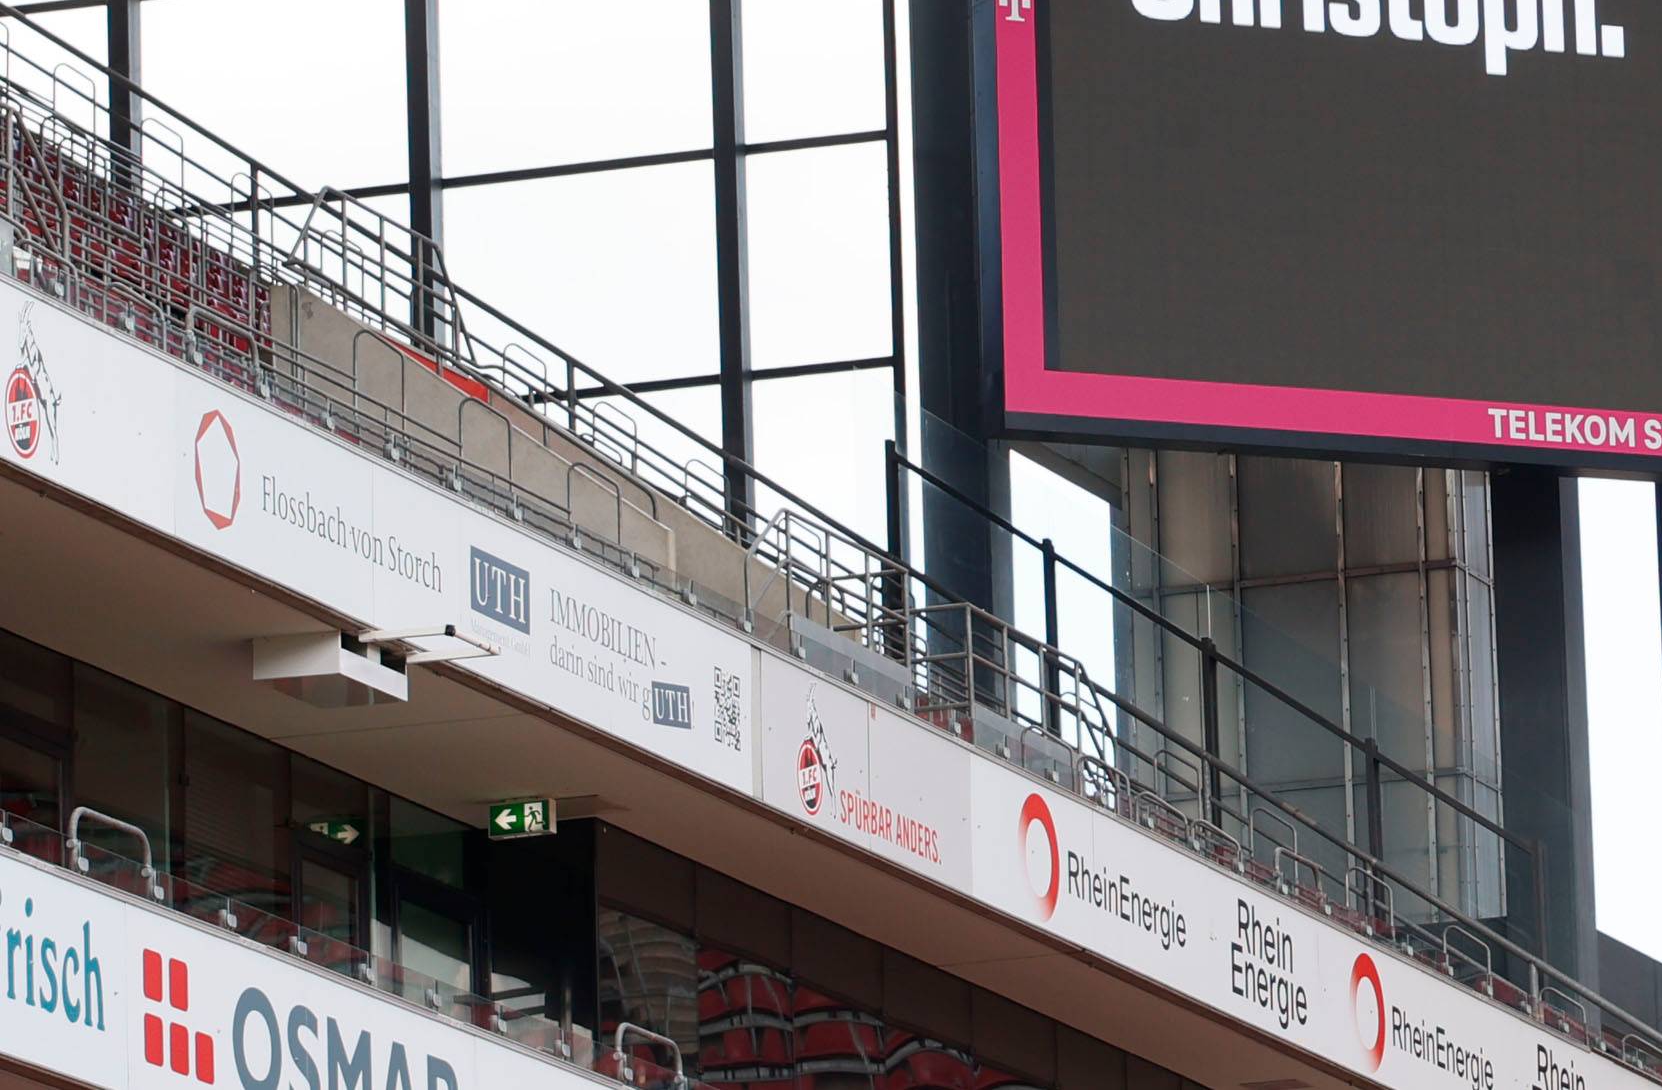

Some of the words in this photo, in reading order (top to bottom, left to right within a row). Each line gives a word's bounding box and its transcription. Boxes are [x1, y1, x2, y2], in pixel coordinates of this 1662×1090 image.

[1487, 407, 1637, 448] TELEKOM
[262, 474, 348, 549] Flossbach
[350, 525, 384, 566] von
[388, 535, 443, 594] Storch
[473, 556, 527, 624] UTH
[549, 587, 657, 671] IMMOBILIEN
[550, 635, 585, 679] darin
[587, 654, 615, 693] sind
[617, 667, 641, 703] wir
[839, 789, 893, 843] SPÜRBAR
[896, 813, 943, 866] ANDERS.
[1067, 850, 1187, 951] RheinEnergie
[1237, 897, 1294, 974] Rhein
[0, 888, 105, 1032] risch
[1230, 941, 1308, 1030] Energie
[1391, 1005, 1494, 1090] RheinEnergie
